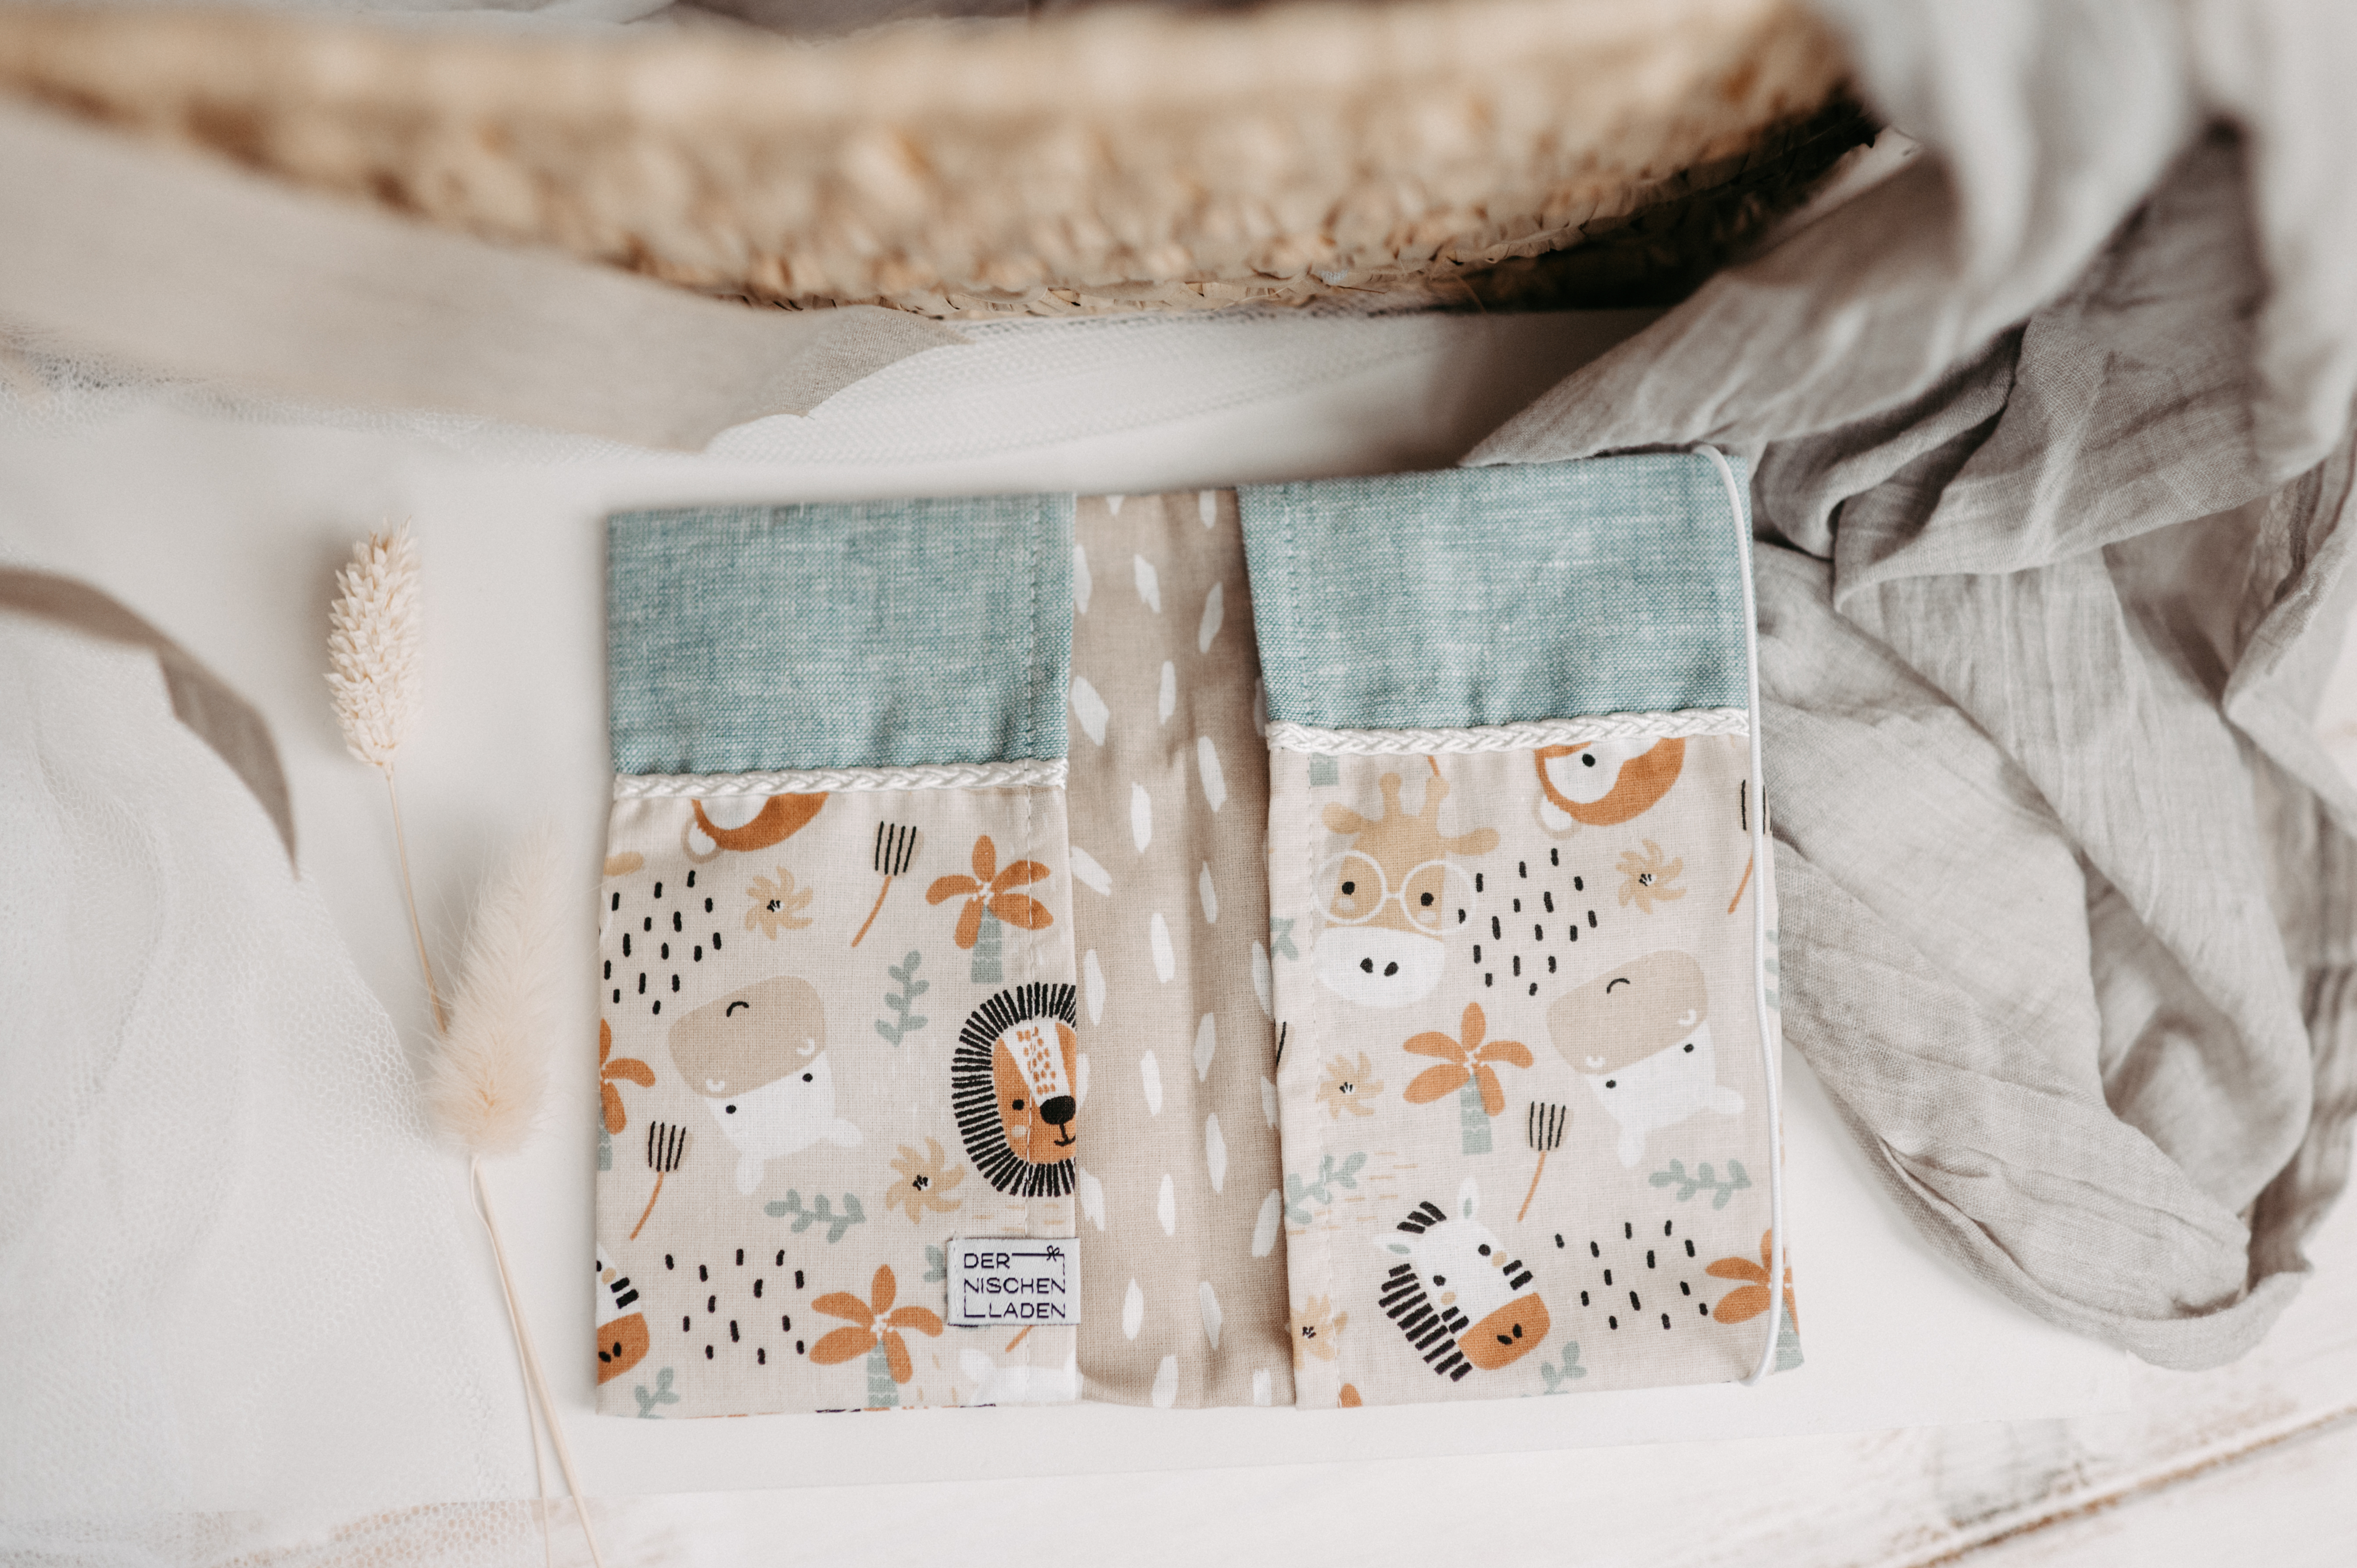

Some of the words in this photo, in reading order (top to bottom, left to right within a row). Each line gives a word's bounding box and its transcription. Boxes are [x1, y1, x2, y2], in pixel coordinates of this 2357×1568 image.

[964, 1253, 1010, 1269] DER
[964, 1277, 1065, 1294] NISCHEN
[989, 1302, 1065, 1318] LADEN
